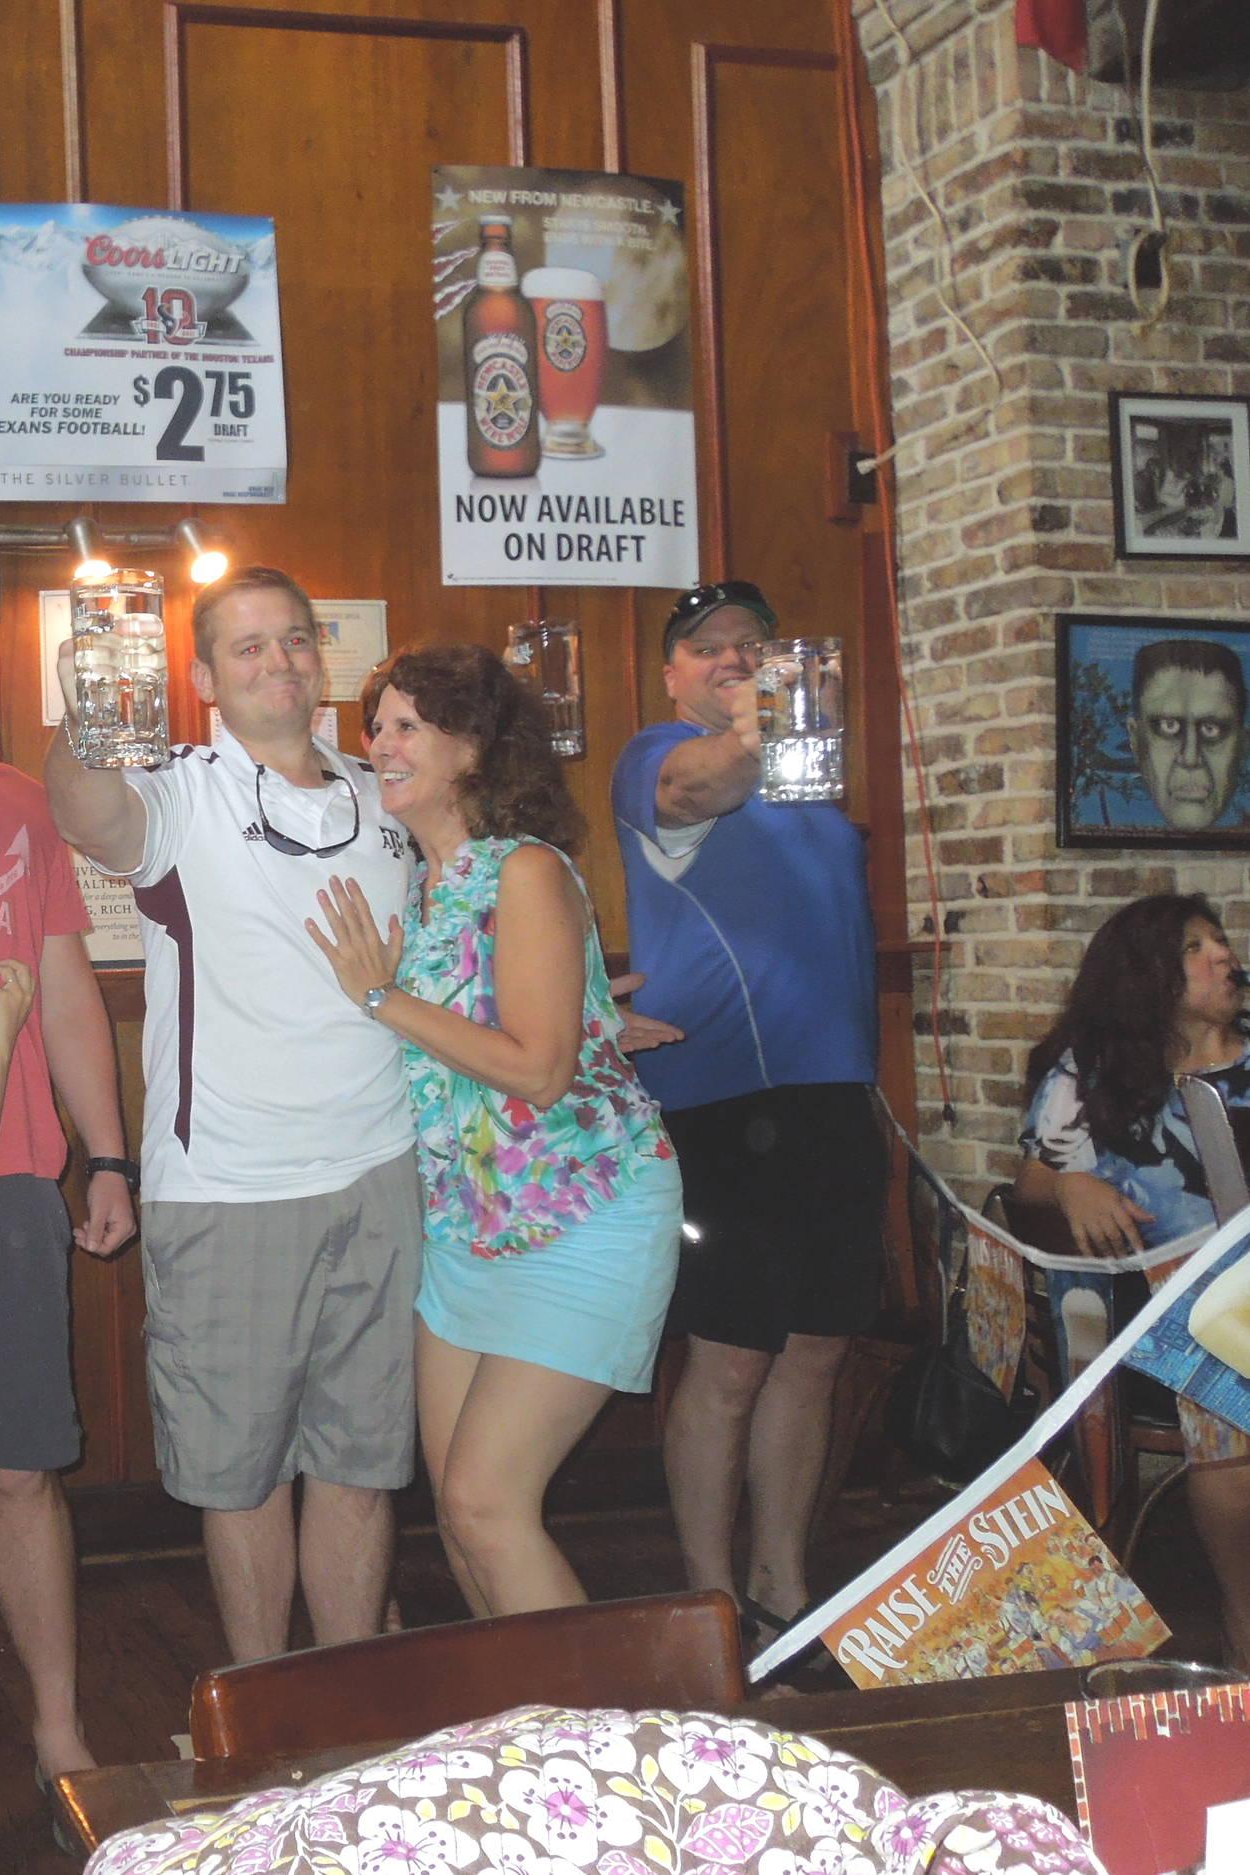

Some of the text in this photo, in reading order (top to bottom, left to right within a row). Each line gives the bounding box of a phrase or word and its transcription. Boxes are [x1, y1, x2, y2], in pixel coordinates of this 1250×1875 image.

[468, 189, 507, 205] NEW
[510, 190, 558, 206] FROM
[85, 233, 247, 274] Coors LIGHT
[10, 393, 121, 407] ARE YOU READY
[29, 406, 103, 419] FOR SOME
[56, 421, 146, 437] FOOTBALL!
[213, 423, 248, 437] DRAFT
[0, 472, 36, 486] THE
[45, 472, 111, 487] SILVER
[455, 493, 686, 528] NOW AVAILABLE
[503, 532, 646, 563] ON DRAFT
[77, 879, 127, 889] ALTED
[100, 904, 132, 914] RICH
[837, 1573, 942, 1681] RAISE
[967, 1479, 1072, 1571] STEIN
